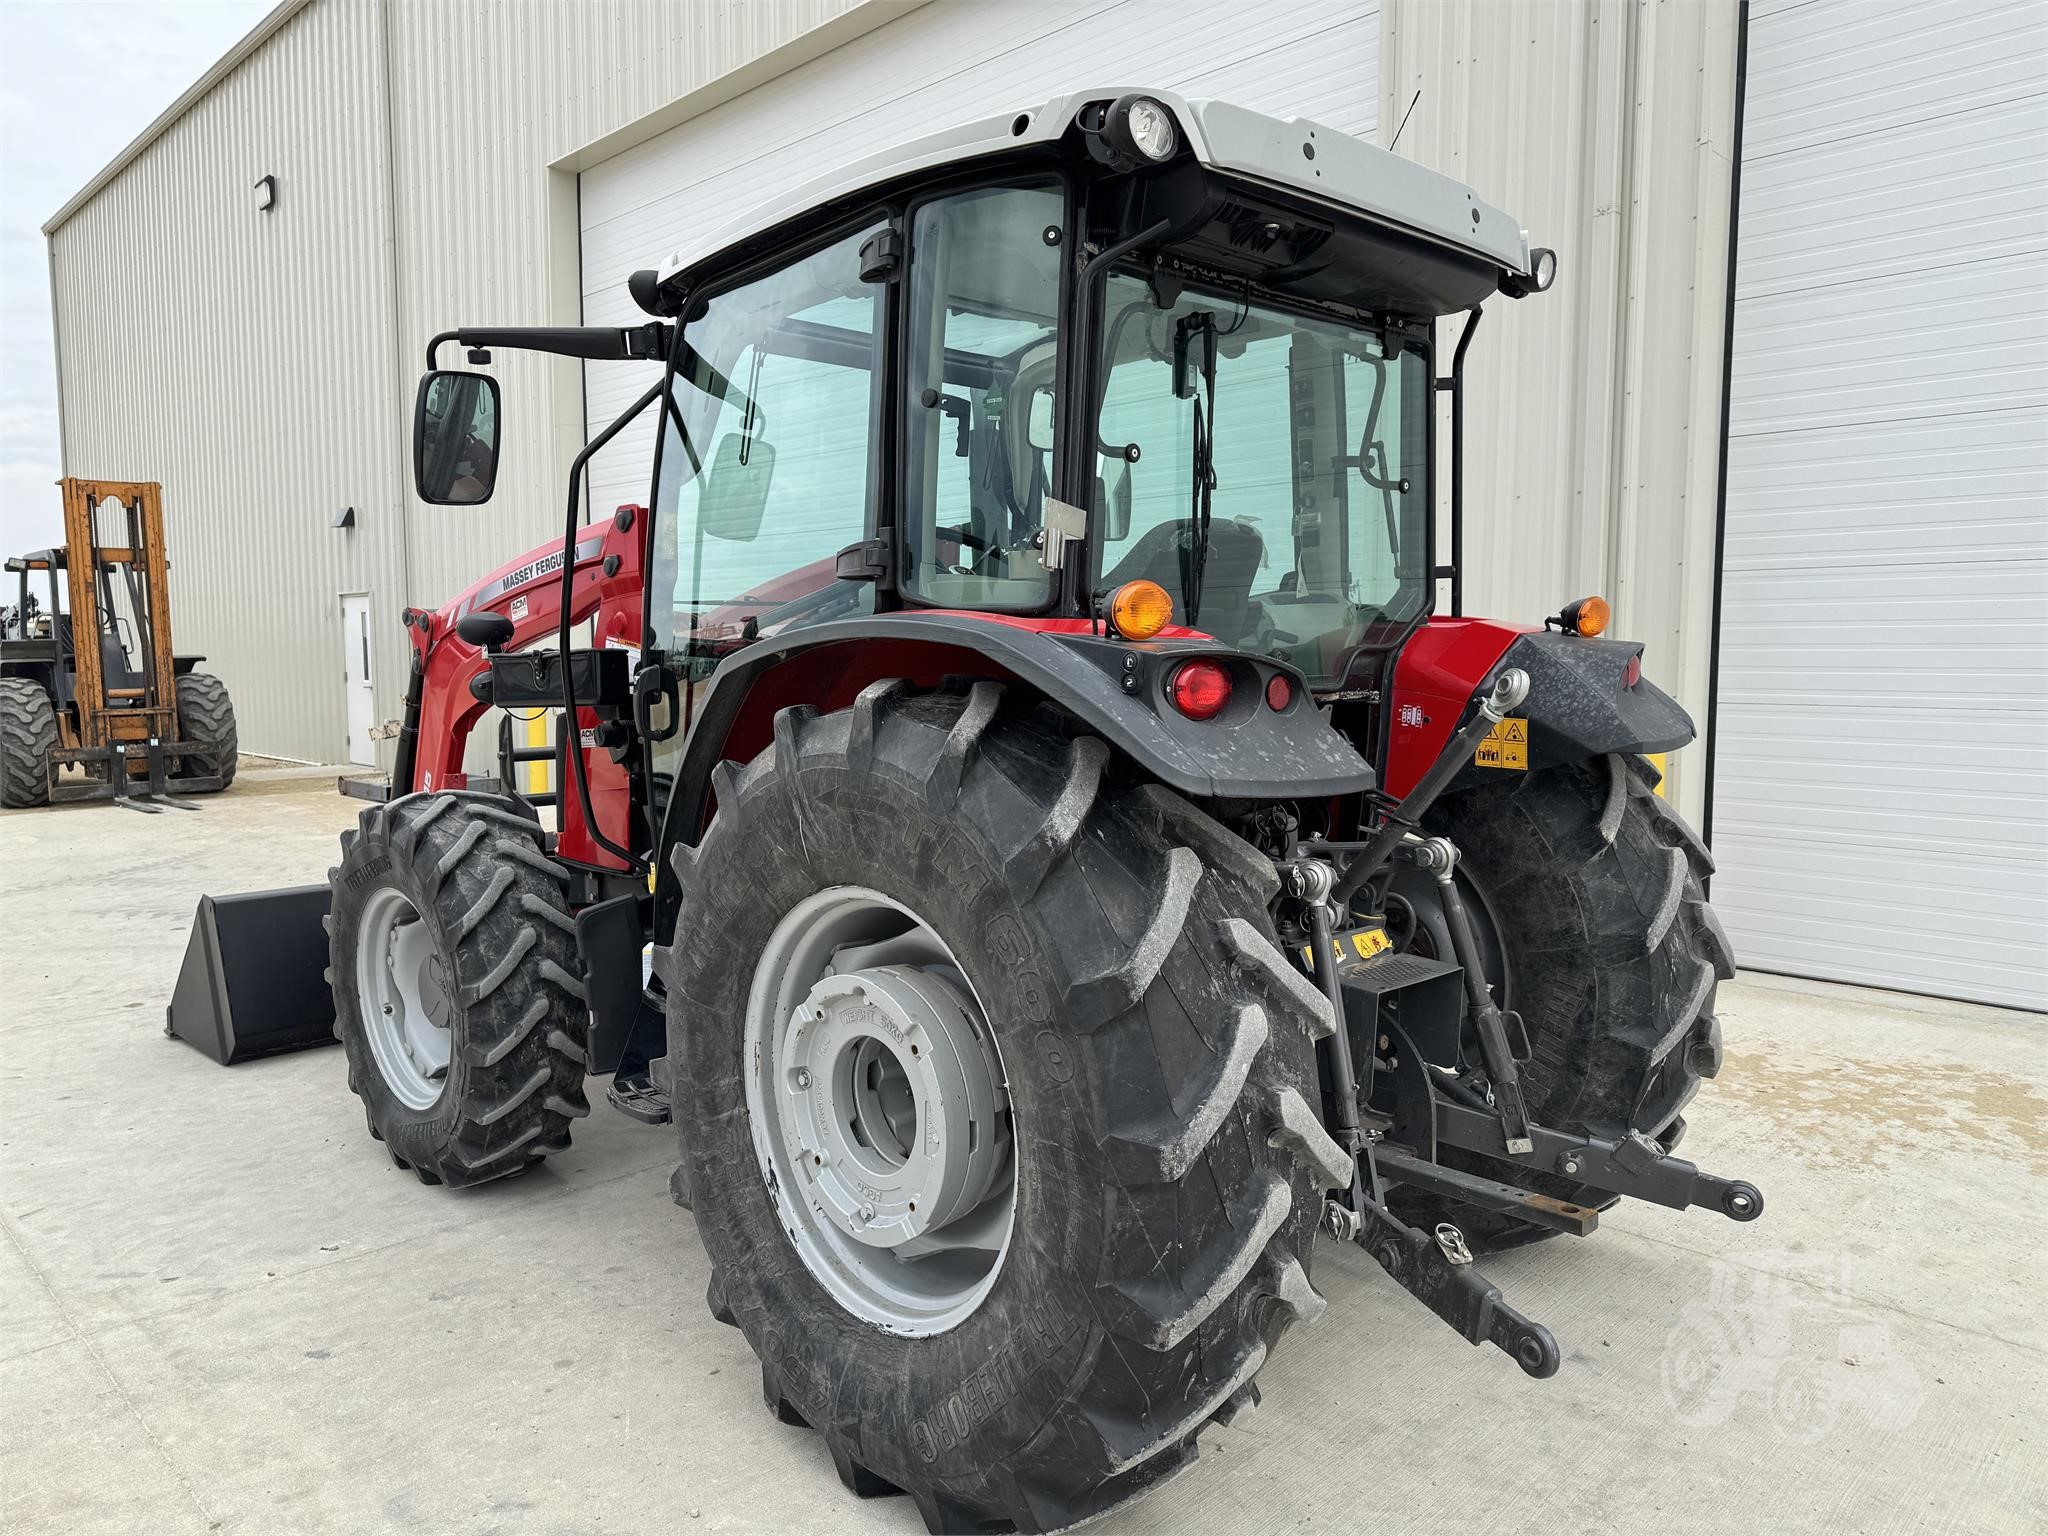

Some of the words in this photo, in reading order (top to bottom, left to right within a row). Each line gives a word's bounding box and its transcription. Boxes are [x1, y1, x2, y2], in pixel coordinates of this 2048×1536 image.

[502, 564, 534, 591] MASSEY
[535, 546, 580, 576] FERGUSN
[511, 597, 527, 611] ACM
[841, 1008, 874, 1026] WEIGHT
[909, 1291, 1081, 1464] TRELLEBORG
